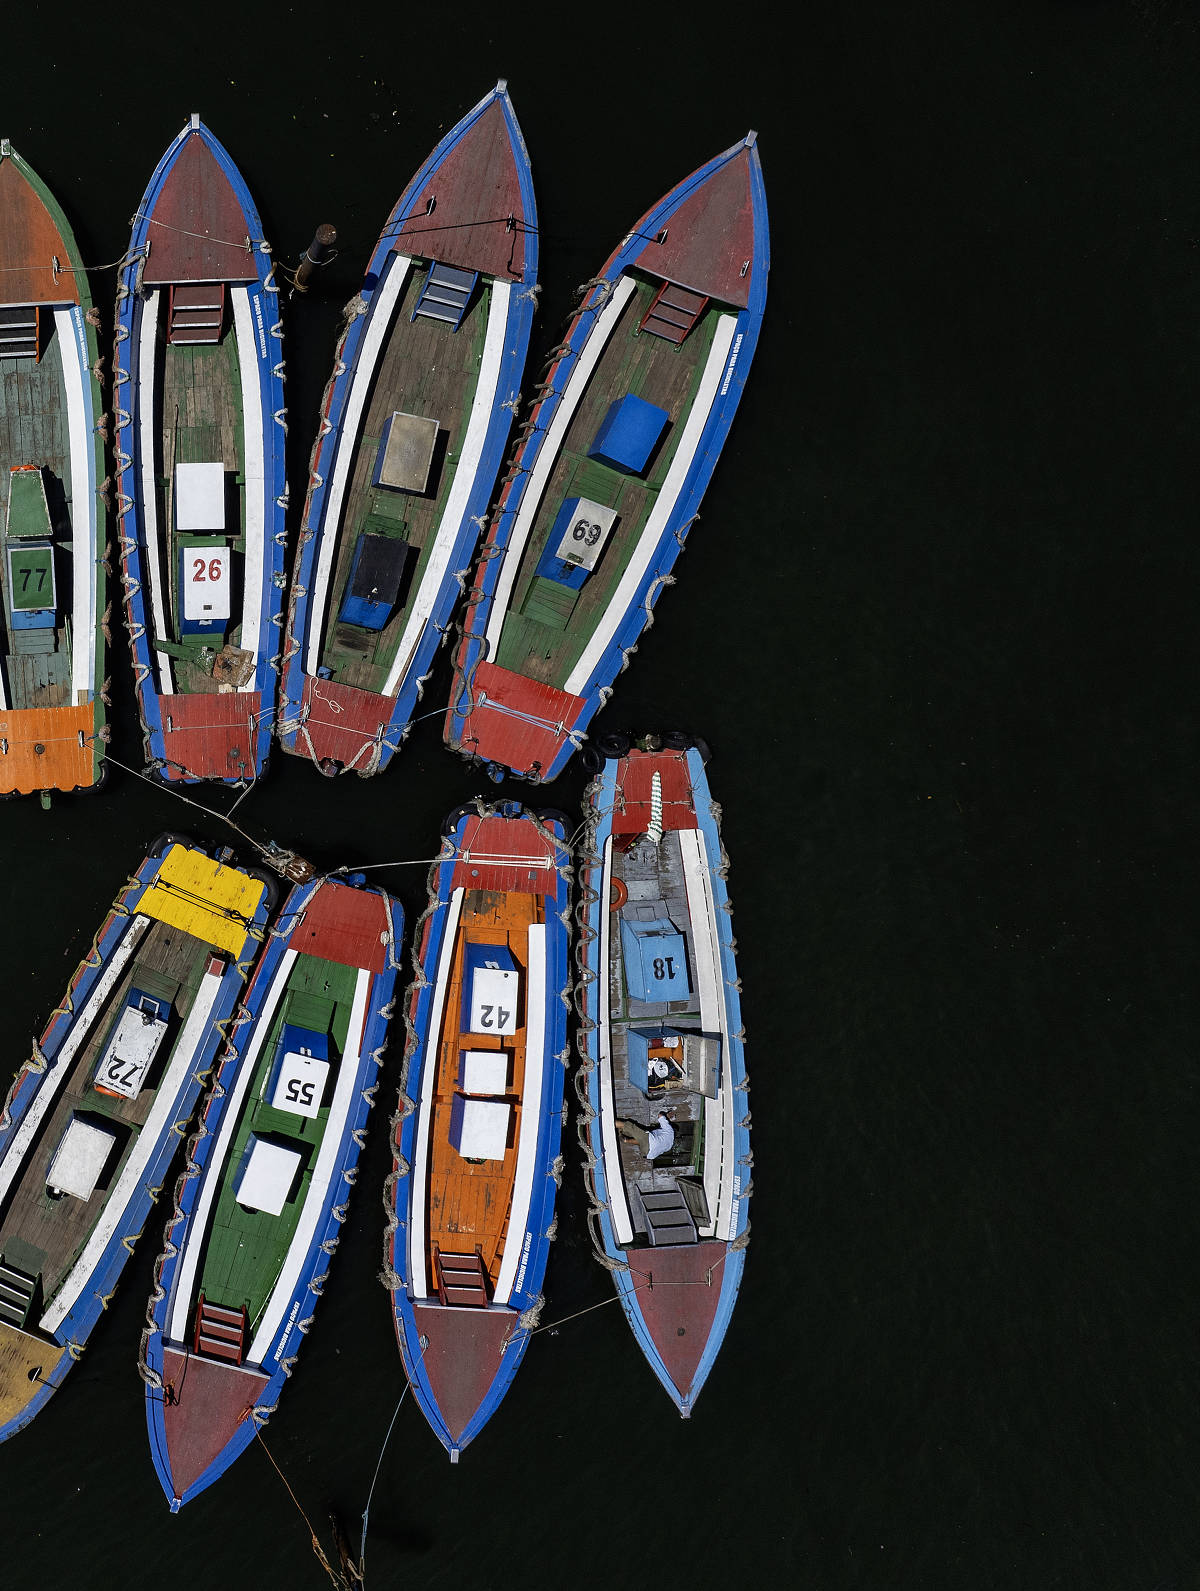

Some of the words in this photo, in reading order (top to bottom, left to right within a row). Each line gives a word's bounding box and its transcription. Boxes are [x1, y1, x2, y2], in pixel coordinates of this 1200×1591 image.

[572, 518, 602, 547] 69
[19, 568, 47, 592] 77
[193, 558, 221, 582] 26
[652, 957, 676, 980] 18
[480, 1005, 510, 1029] 42
[108, 1055, 139, 1087] 72
[285, 1078, 315, 1106] 55
[521, 1251, 529, 1265] PARA
[284, 1320, 294, 1334] PARA
